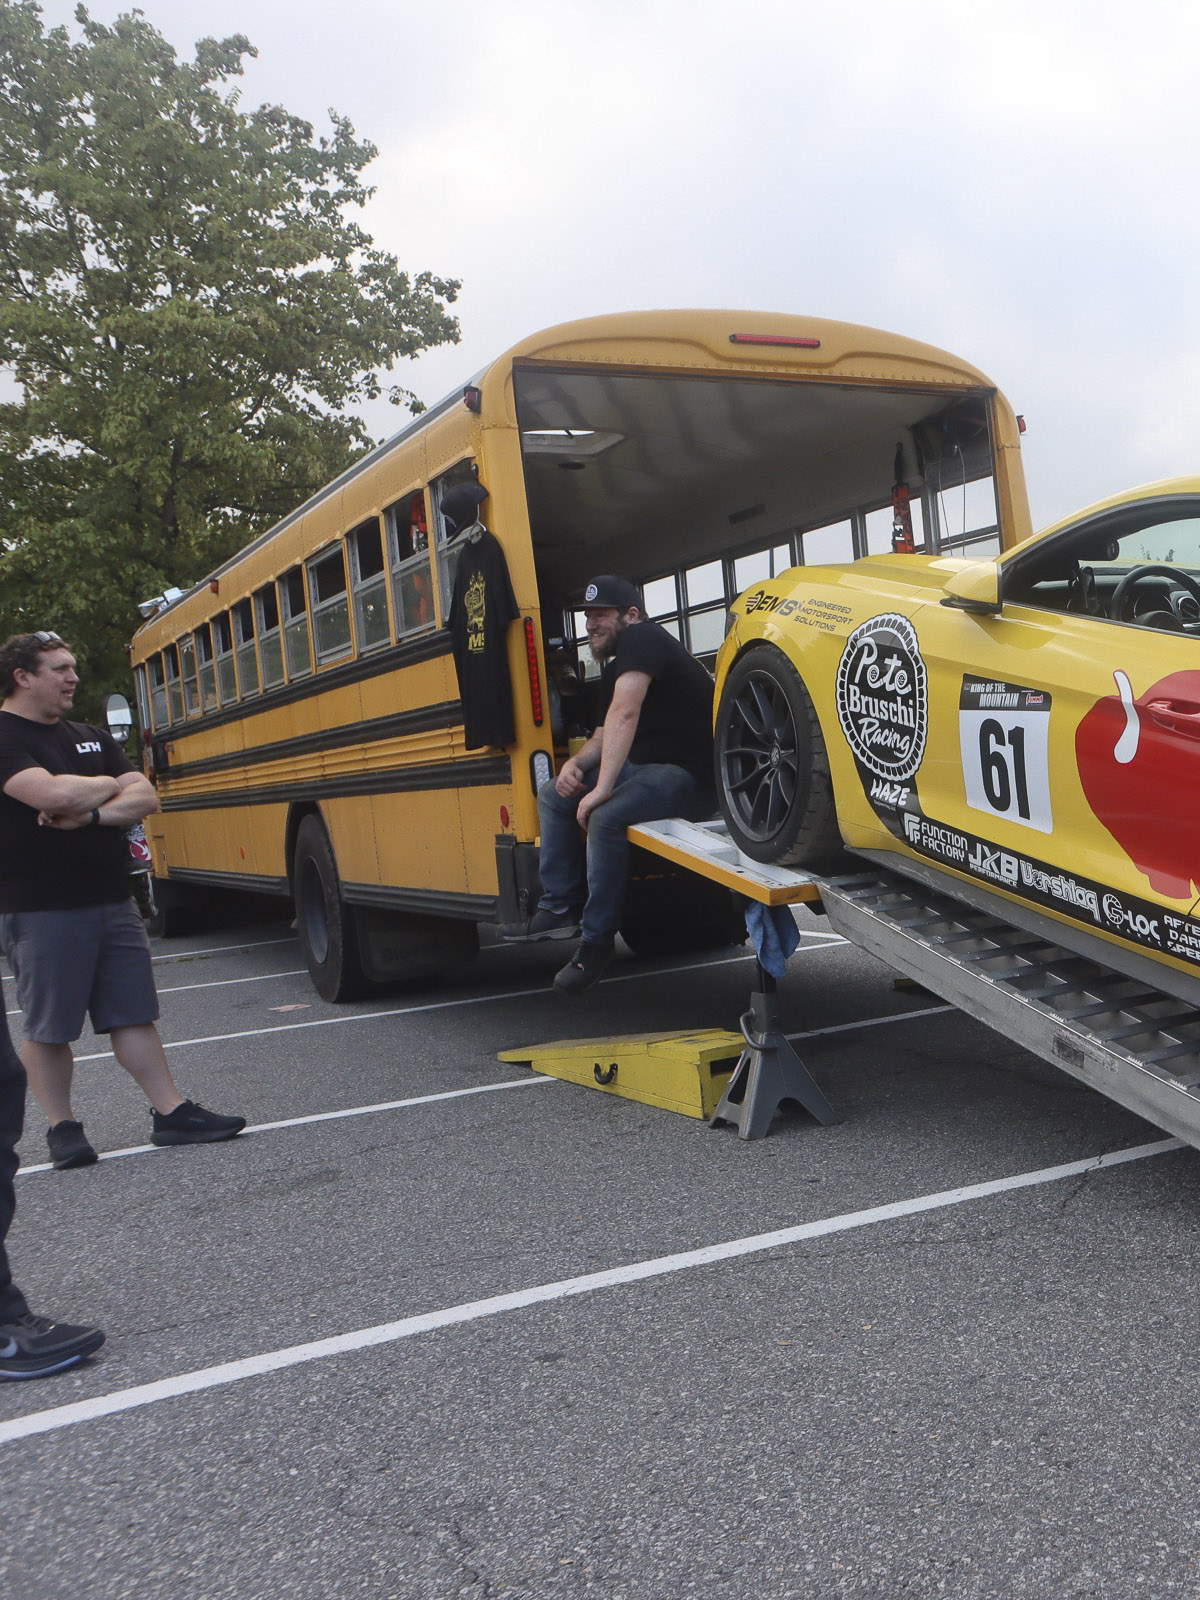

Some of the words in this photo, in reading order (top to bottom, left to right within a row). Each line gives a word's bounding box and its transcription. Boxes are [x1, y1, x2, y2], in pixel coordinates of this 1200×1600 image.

[801, 607, 854, 625] MOTORSPORT
[808, 599, 852, 614] ENGINEERED
[794, 615, 836, 632] SOLUTIONS
[855, 637, 912, 695] Pete
[970, 683, 985, 693] KING
[986, 683, 994, 692] OF
[994, 683, 1006, 692] THE
[979, 693, 1019, 707] MOUNTAIN
[849, 684, 915, 728] Bruschi
[858, 717, 910, 758] Racing
[979, 718, 1030, 820] 61
[870, 779, 911, 806] HAZE
[921, 822, 968, 850] FUNCTION
[922, 835, 965, 862] FACTORY
[968, 842, 1019, 881] JXB
[969, 863, 1018, 888] PERFORMANCE
[1102, 893, 1161, 941] G-LOC
